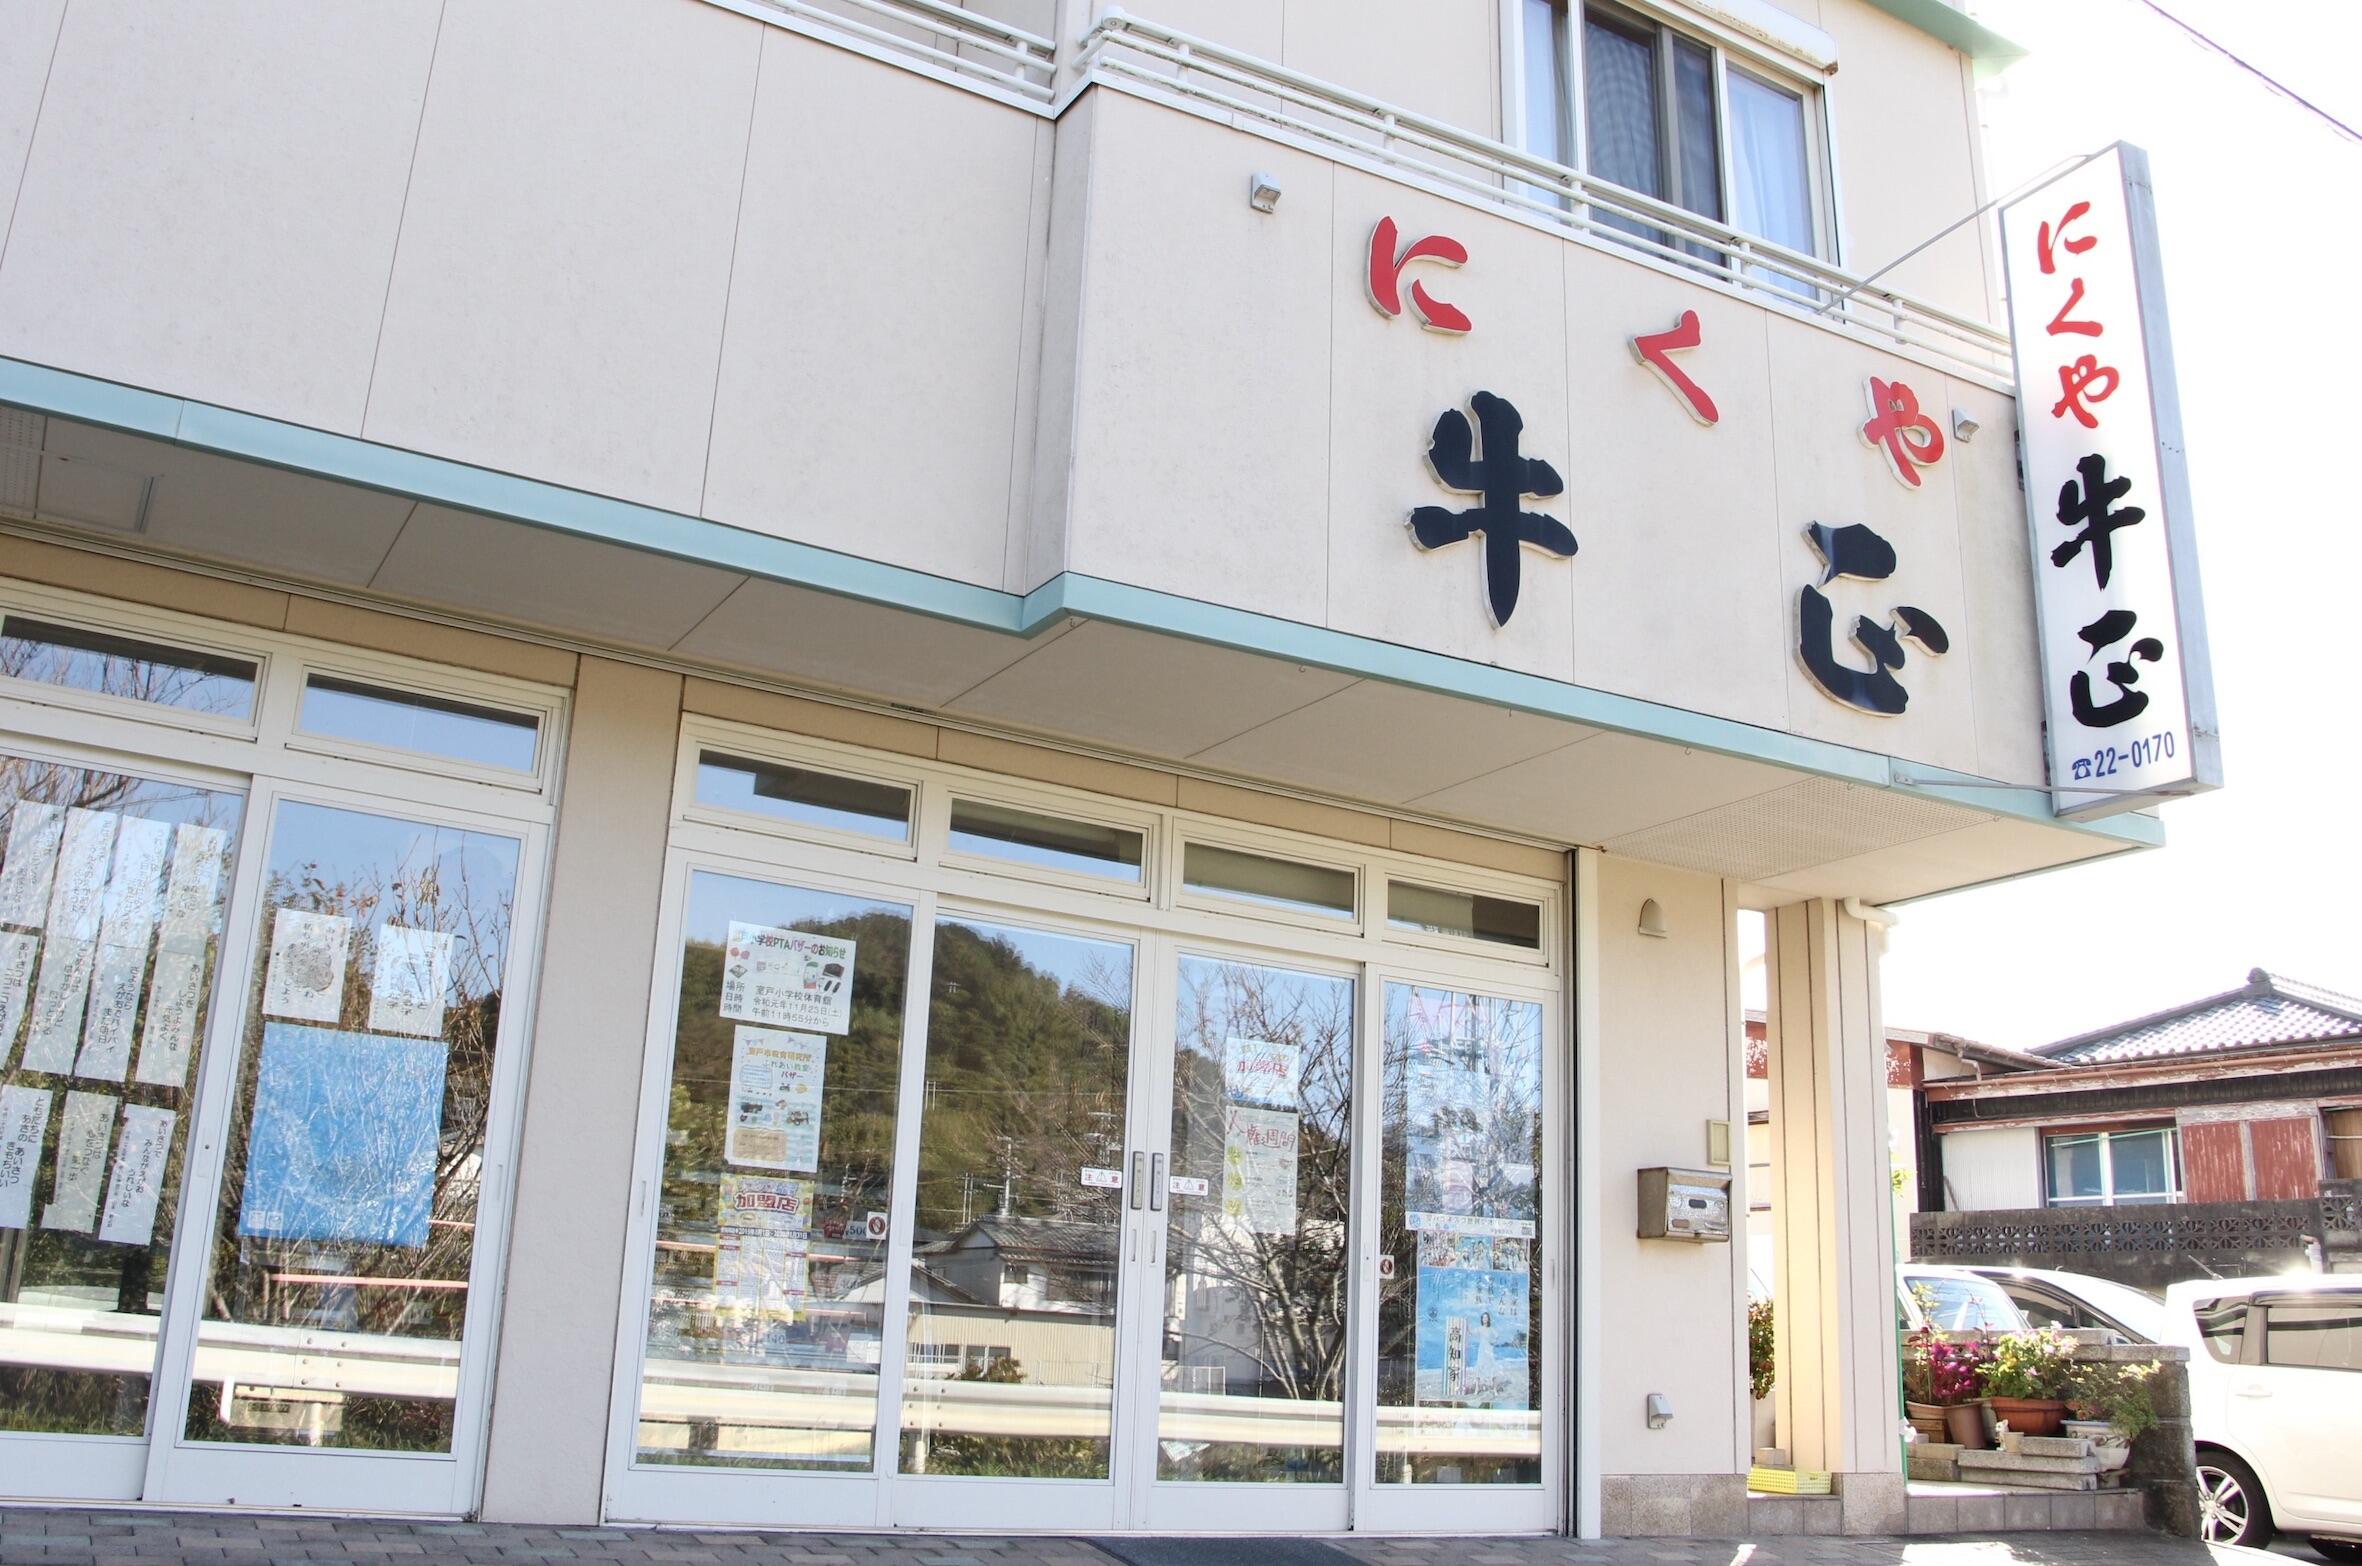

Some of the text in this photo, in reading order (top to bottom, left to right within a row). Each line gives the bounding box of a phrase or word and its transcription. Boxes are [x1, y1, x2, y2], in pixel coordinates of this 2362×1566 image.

[2037, 201, 2120, 429] にくや
[1367, 215, 1945, 490] にくや
[2094, 731, 2176, 780] 22-0170
[123, 966, 140, 1010] さようなら
[185, 963, 201, 1009] あいさつを
[725, 992, 743, 1003] 日時
[726, 980, 833, 1006] 場所 室戸小学校体育館
[98, 1007, 112, 1045] また明日
[106, 982, 127, 1053] えがおでバイバイ
[723, 1003, 830, 1027] 時間 午前11時55分から
[780, 1070, 804, 1079] バザー
[28, 1096, 45, 1144] ともだちに
[92, 1113, 108, 1160] あいさつは
[11, 1114, 31, 1185] あさの あいさつ
[121, 1167, 136, 1208] うれしいな
[735, 1193, 799, 1215] 加盟店
[1448, 1327, 1462, 1382] 高知家
